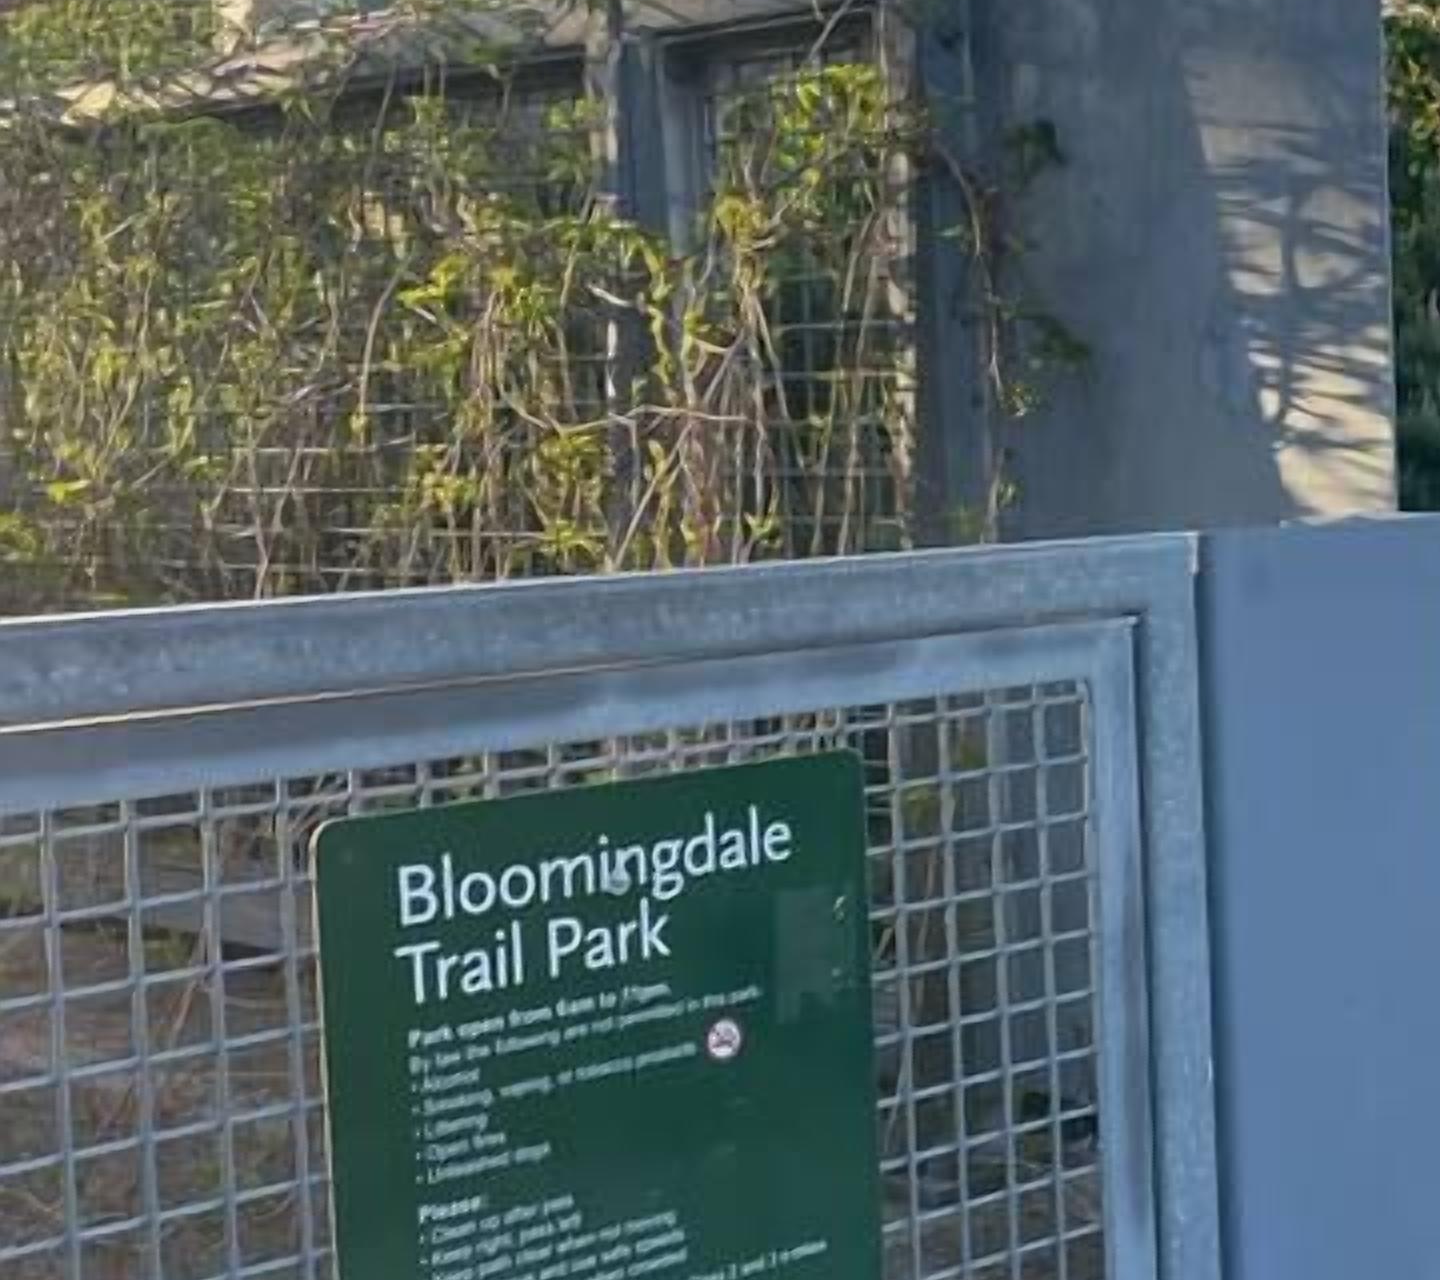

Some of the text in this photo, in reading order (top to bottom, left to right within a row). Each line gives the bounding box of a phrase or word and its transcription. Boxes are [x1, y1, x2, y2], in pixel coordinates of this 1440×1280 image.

[398, 804, 792, 926] Bloomingdale
[393, 897, 672, 1004] Trail Park
